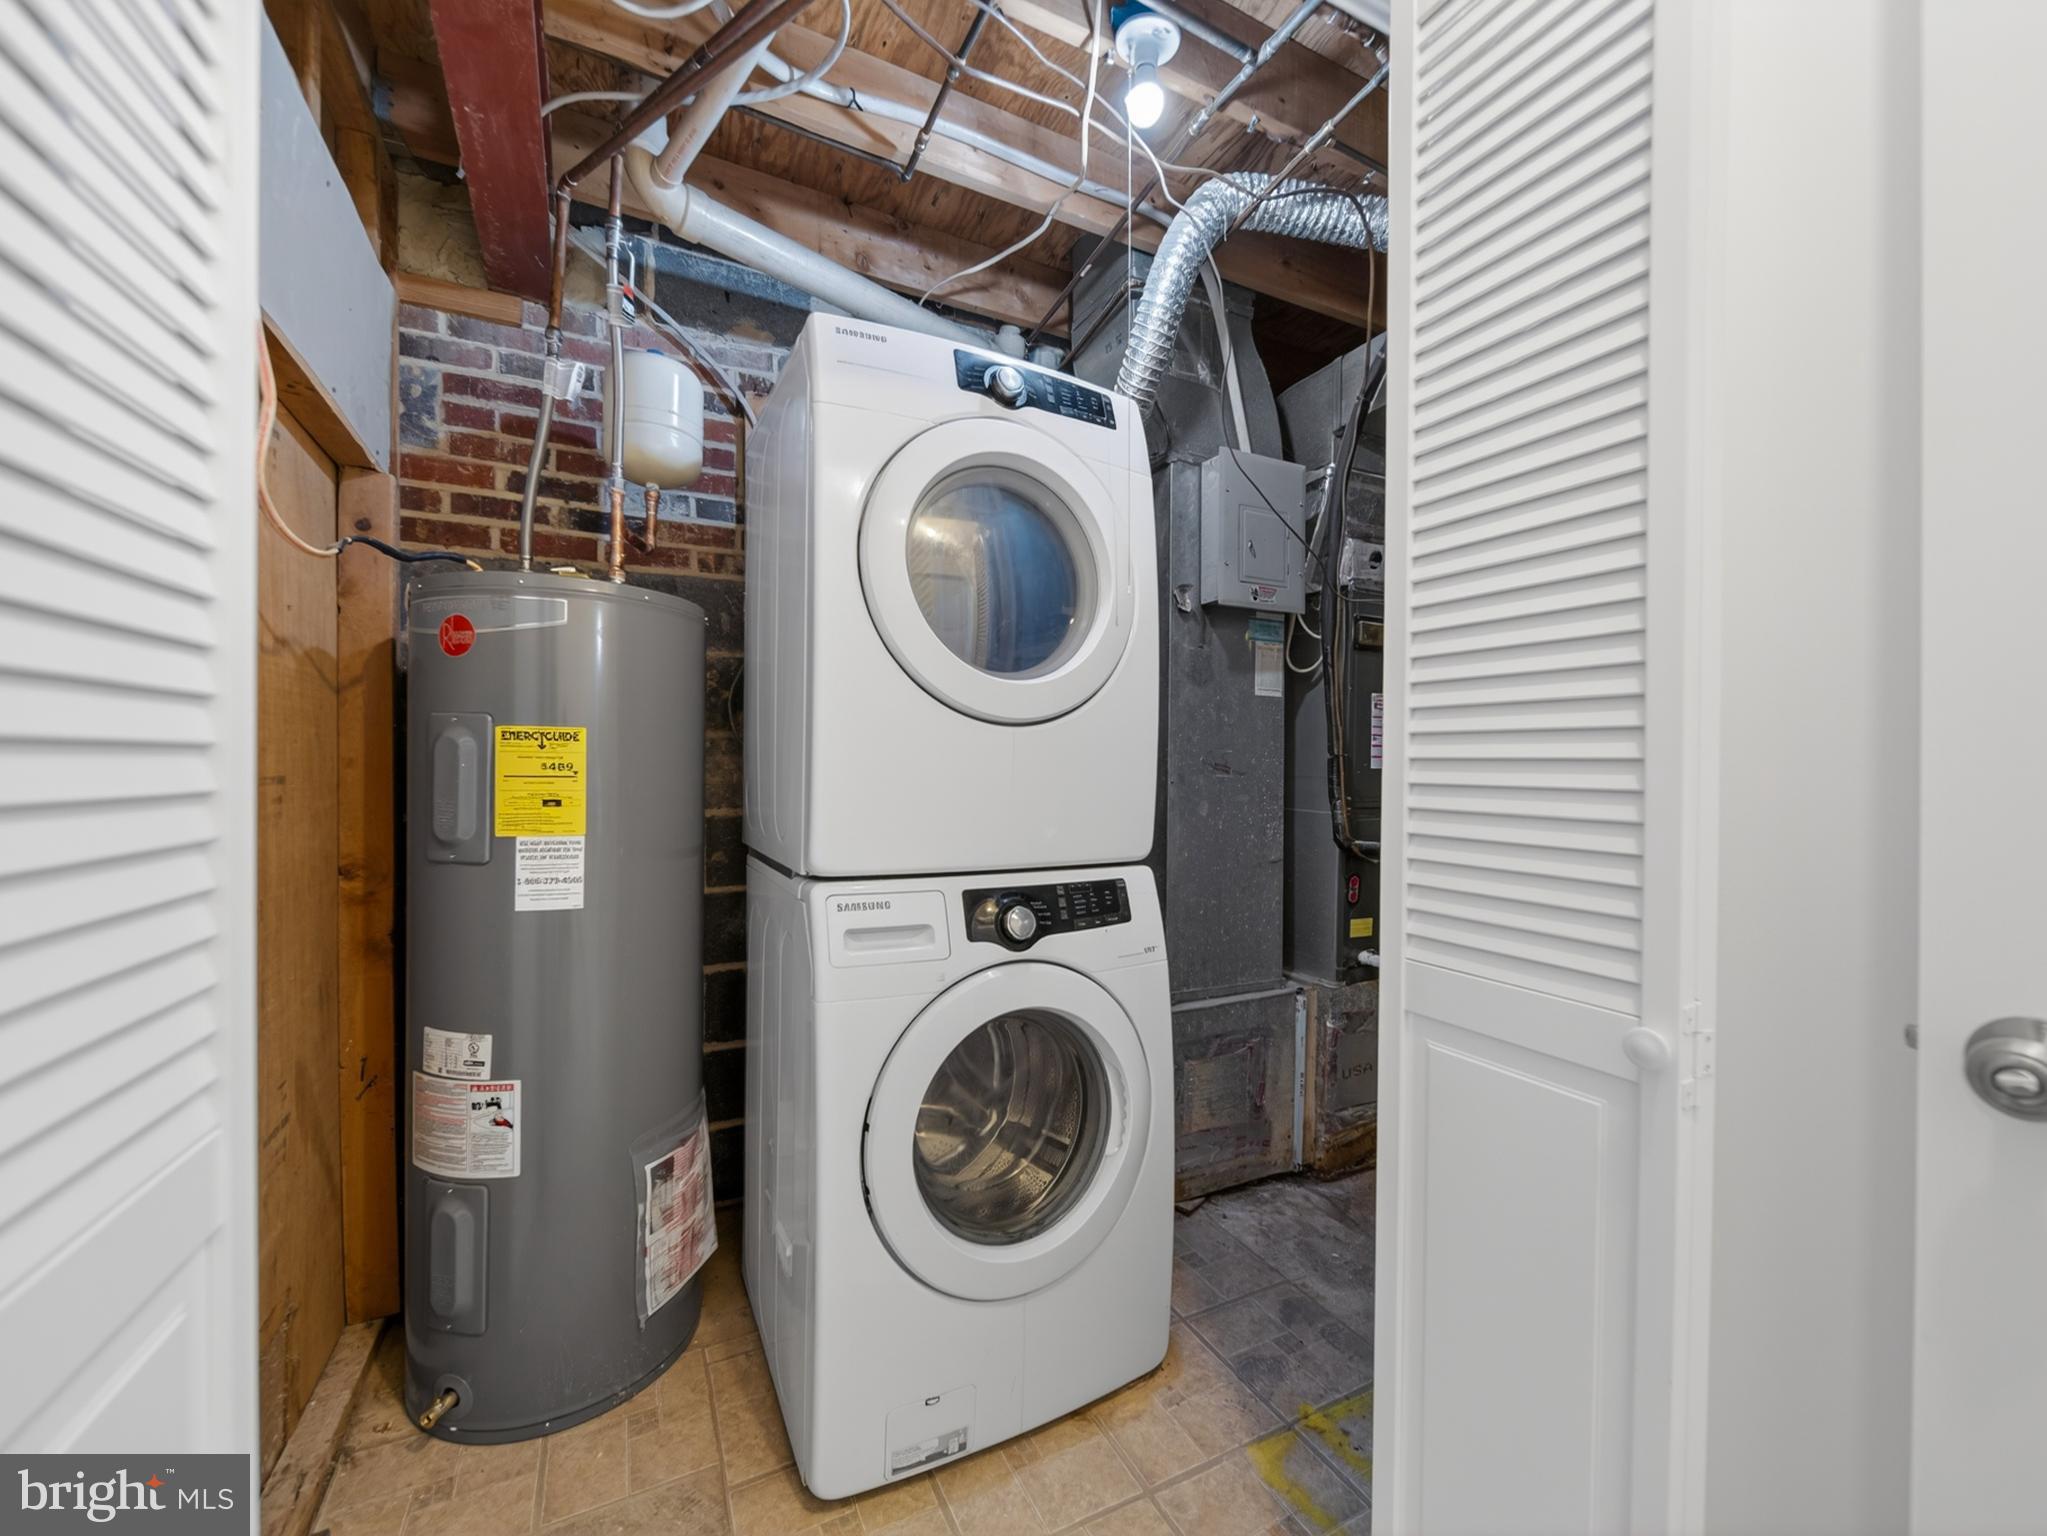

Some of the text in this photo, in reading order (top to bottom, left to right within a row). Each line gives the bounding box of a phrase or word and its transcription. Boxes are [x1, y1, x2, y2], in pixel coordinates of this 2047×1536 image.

[835, 326, 888, 343] SAMSUNG
[836, 900, 891, 912] SAMSUNG
[1341, 1061, 1374, 1081] USA
